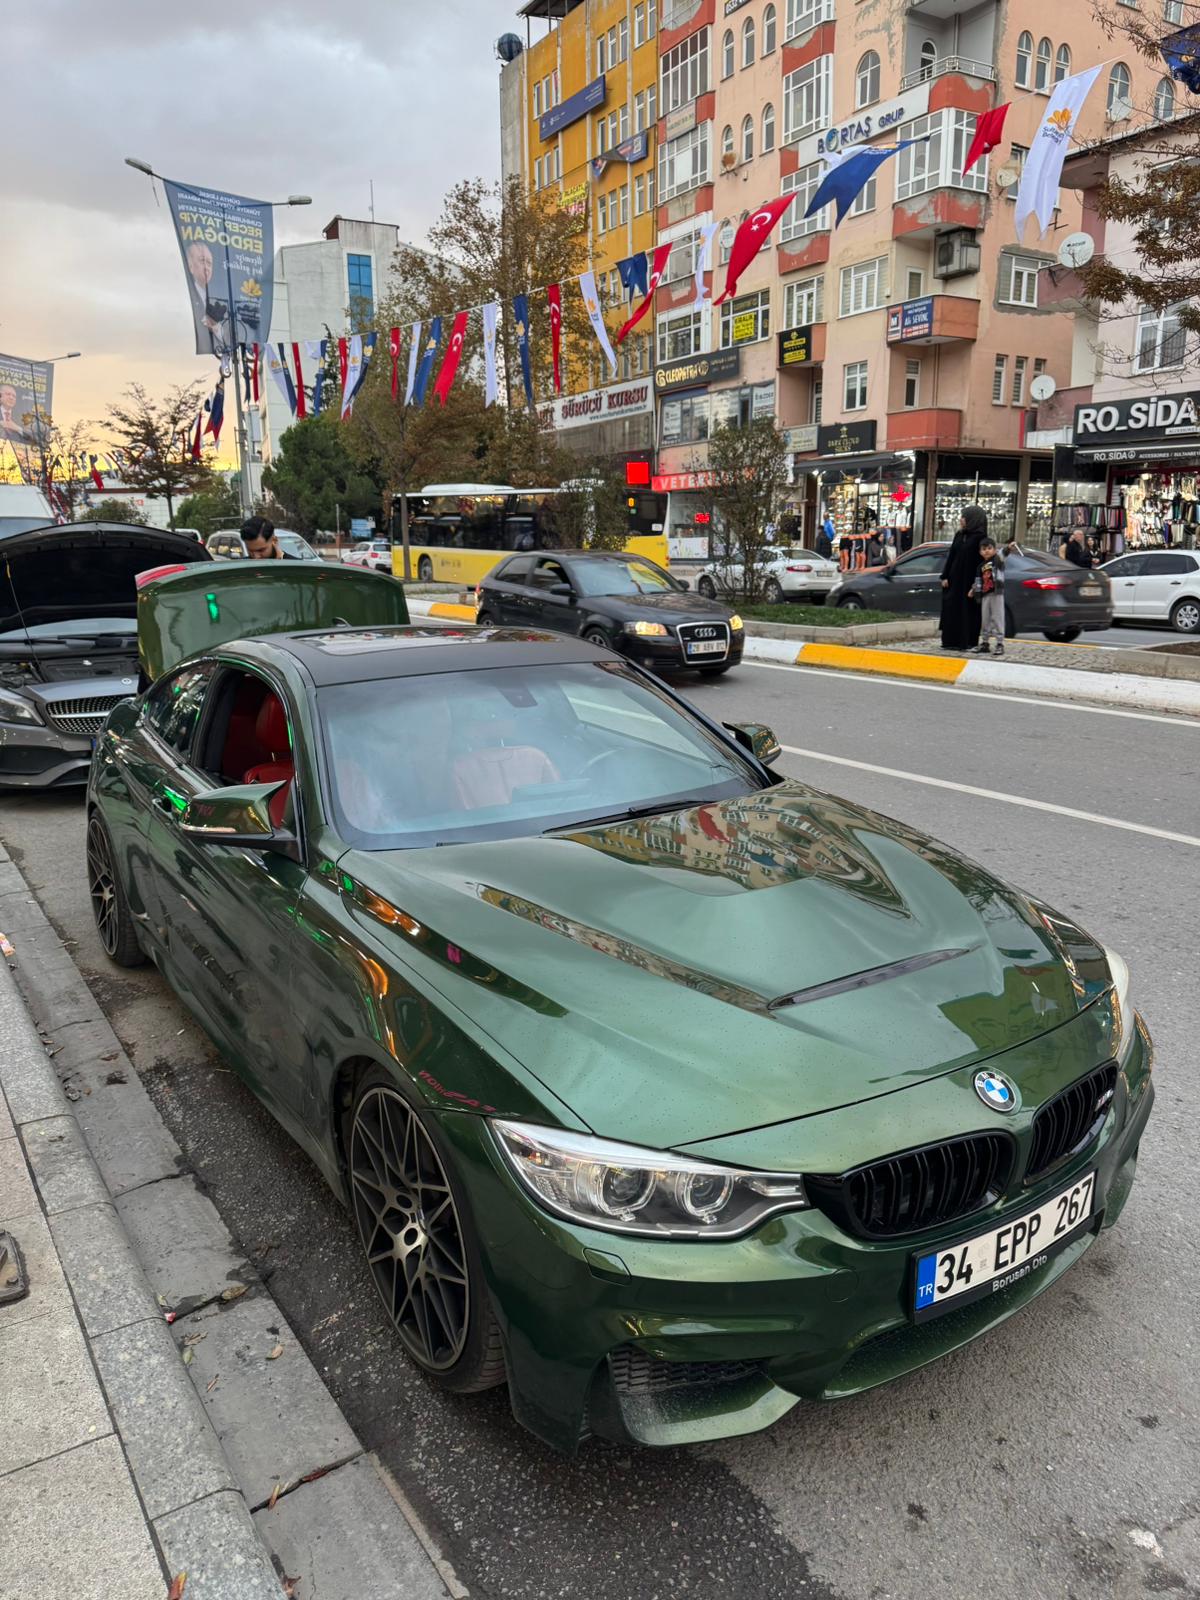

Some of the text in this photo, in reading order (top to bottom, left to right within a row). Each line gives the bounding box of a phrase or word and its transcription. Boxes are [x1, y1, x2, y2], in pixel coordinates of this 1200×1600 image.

[878, 107, 905, 128] GRUP
[561, 391, 603, 420] SÜRÜCÜ
[607, 386, 648, 410] KURSU
[1077, 397, 1198, 434] RO_SİDA
[1094, 450, 1127, 461] RO_SİDA
[936, 1176, 1092, 1294] 34 EPP 267
[992, 1254, 1048, 1292] Borusan Oto
[918, 1283, 933, 1298] TR
